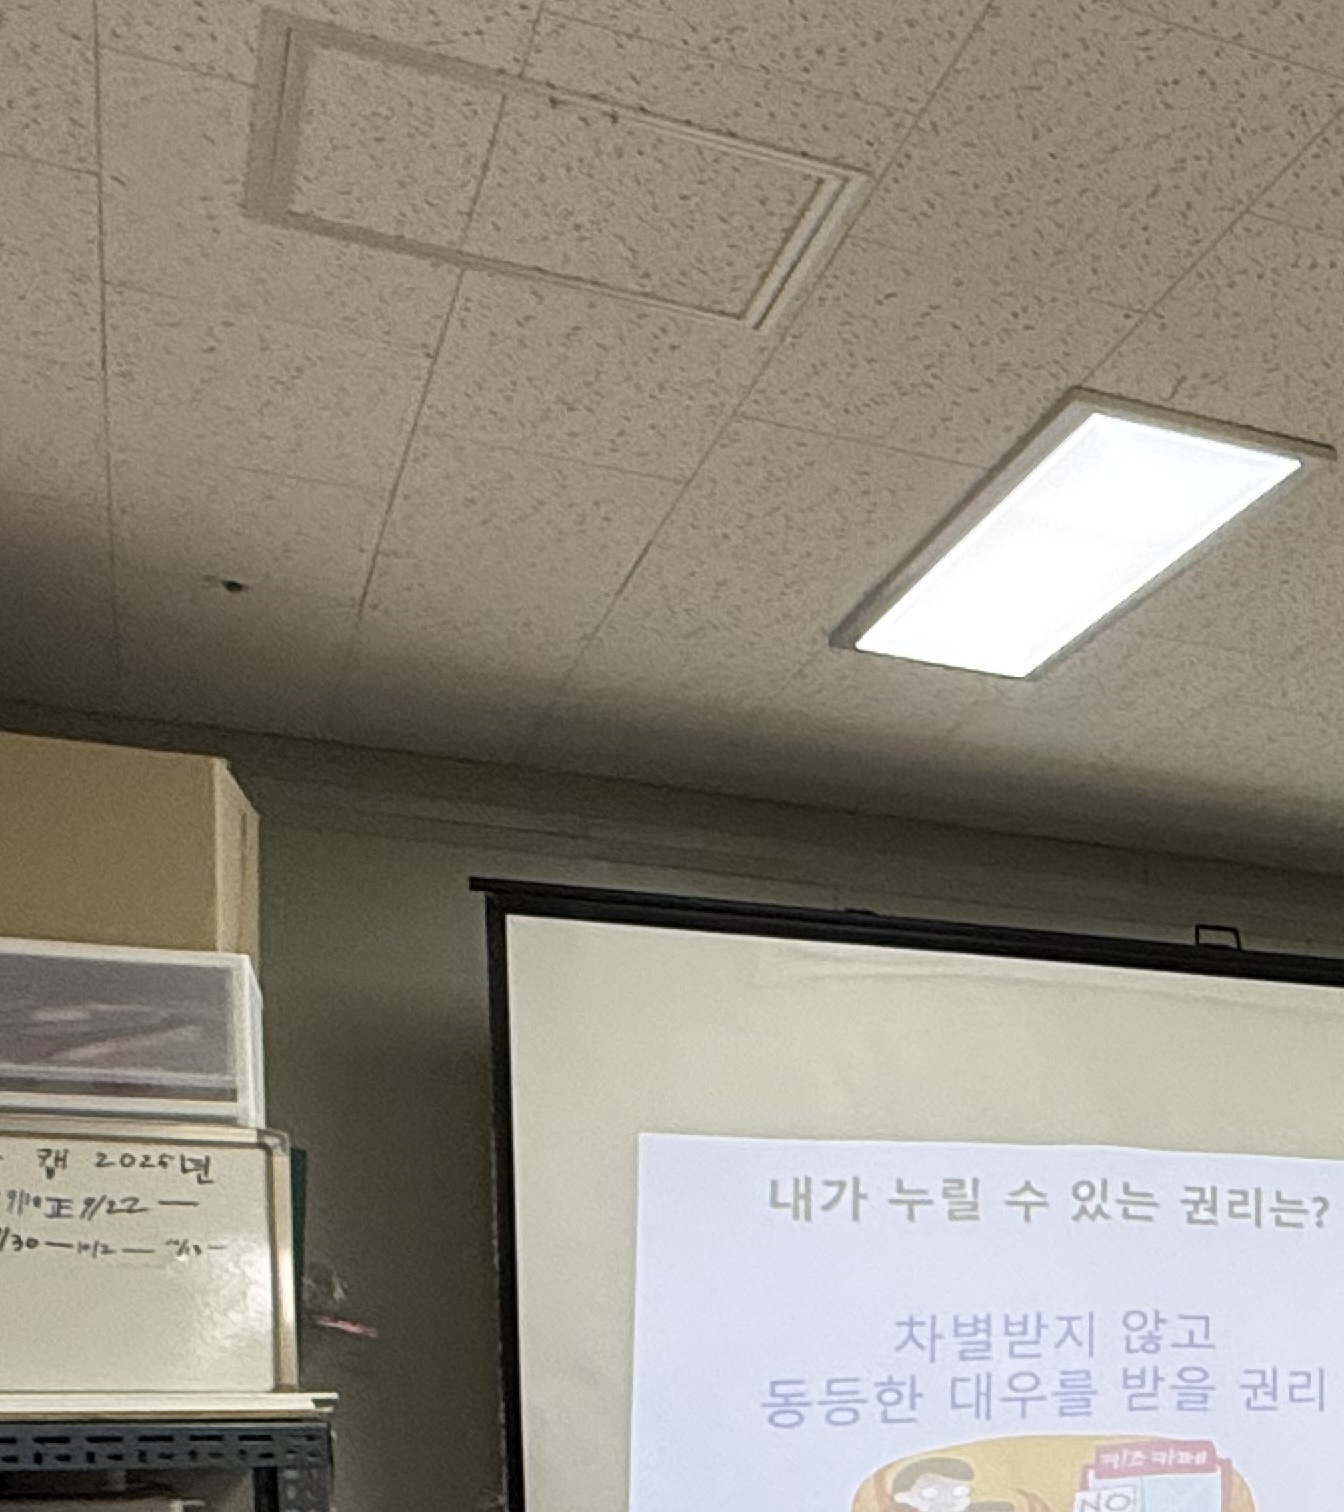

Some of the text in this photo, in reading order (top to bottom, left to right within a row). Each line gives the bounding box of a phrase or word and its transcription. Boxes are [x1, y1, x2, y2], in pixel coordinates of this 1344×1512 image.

[768, 1175, 1330, 1230] 내가 누릴 수 있는 권리는?
[894, 1308, 1217, 1363] 차별받지 않고
[761, 1364, 1327, 1429] 동등한 대우를 받을 권리
